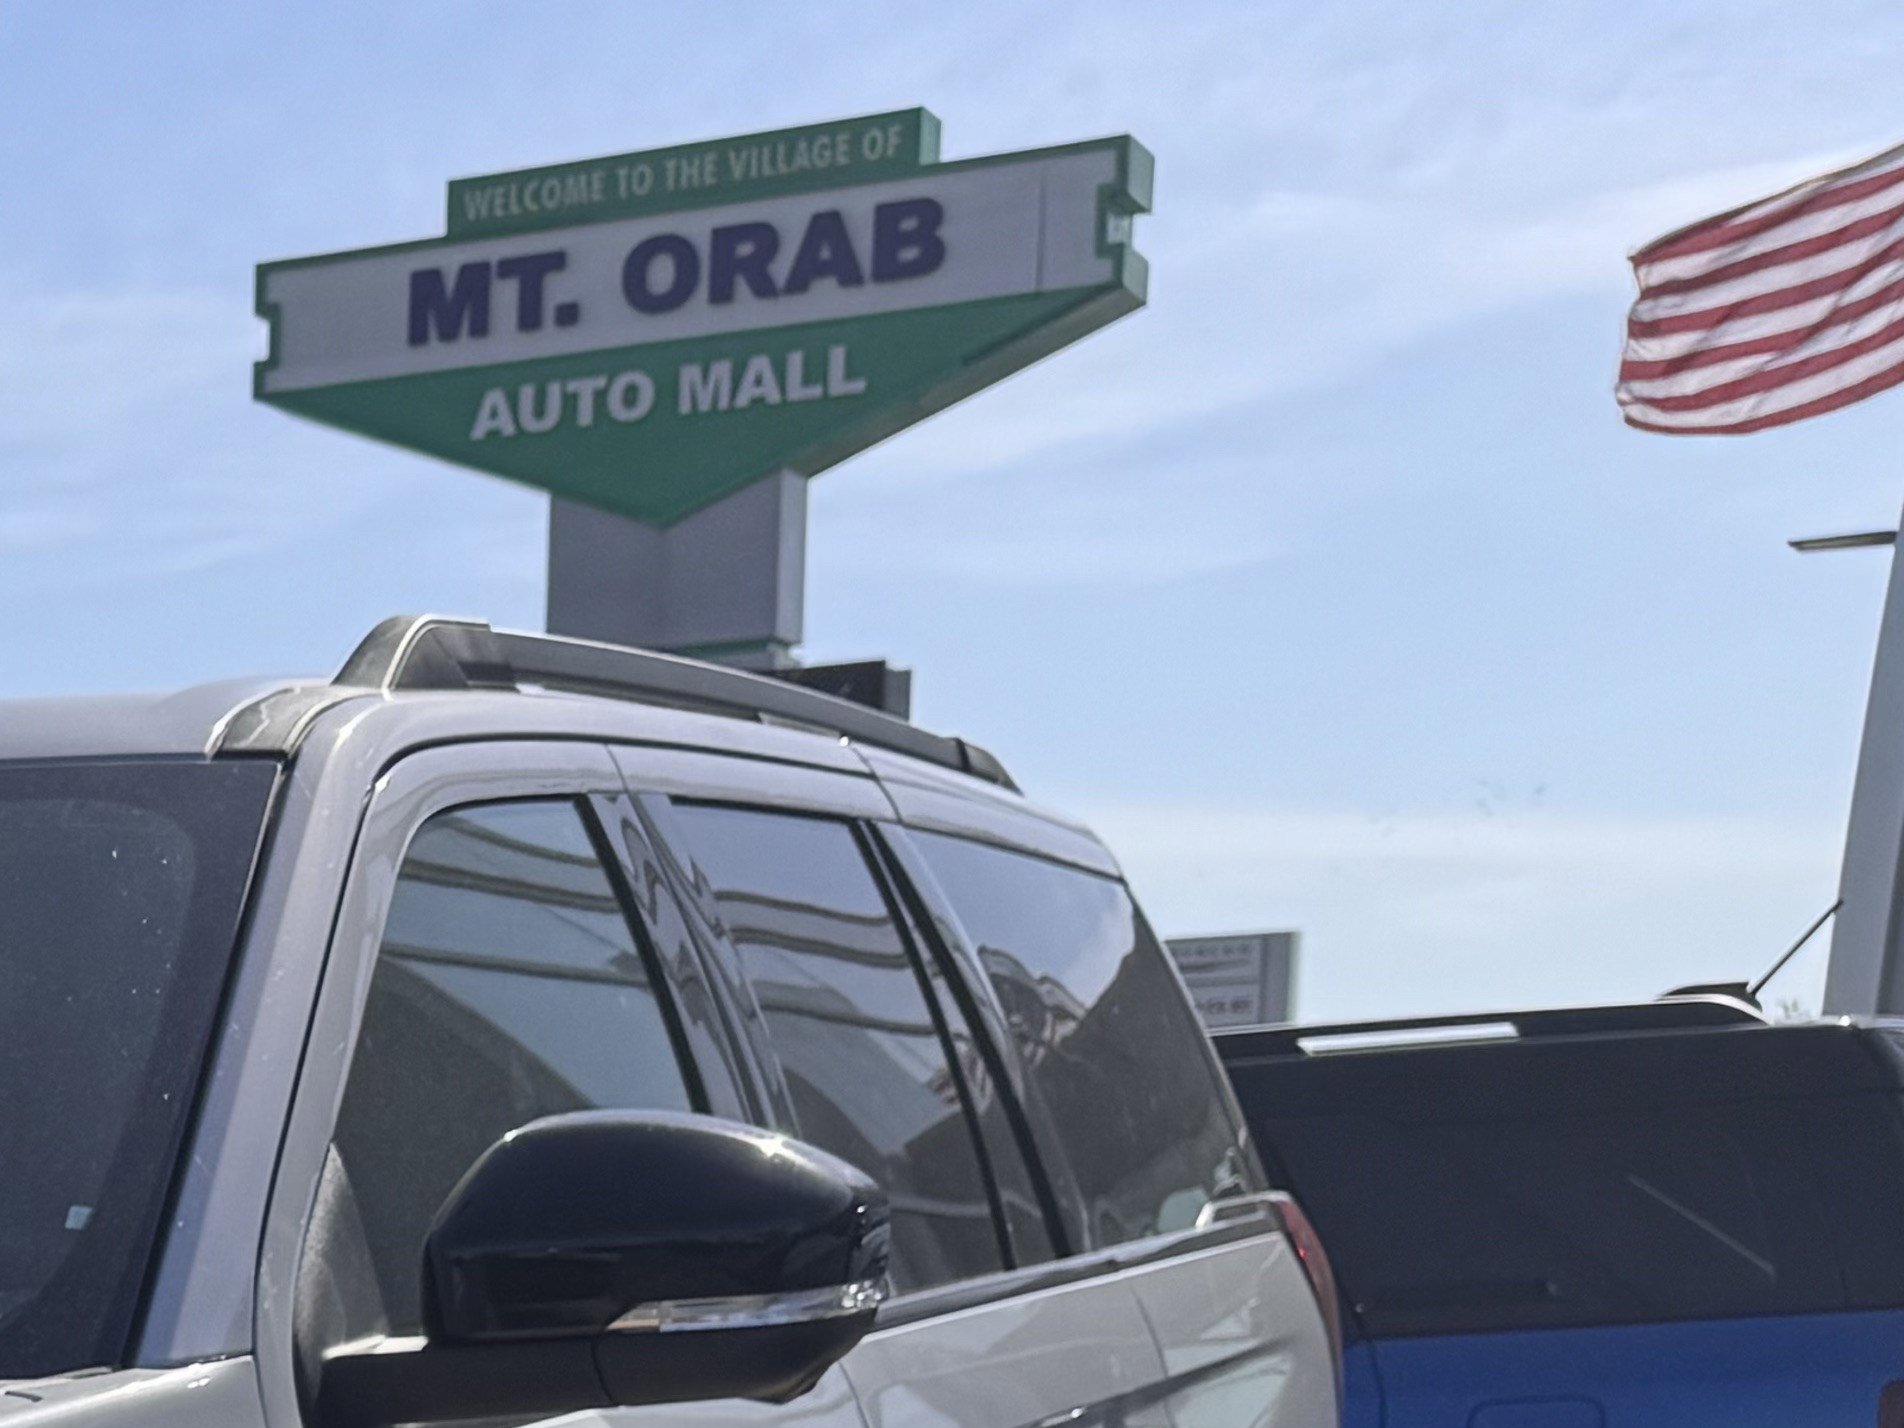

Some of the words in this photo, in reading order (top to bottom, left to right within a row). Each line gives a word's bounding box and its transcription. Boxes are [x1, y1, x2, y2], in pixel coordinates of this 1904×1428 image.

[464, 170, 606, 222] WELCOME
[617, 164, 655, 198] TO
[665, 151, 718, 191] THE
[728, 133, 852, 181] VILLAGE
[861, 125, 903, 160] OF
[406, 251, 580, 347] MT.
[621, 197, 947, 315] ORAB
[470, 371, 656, 442] AUTO
[677, 344, 867, 416] MALL
